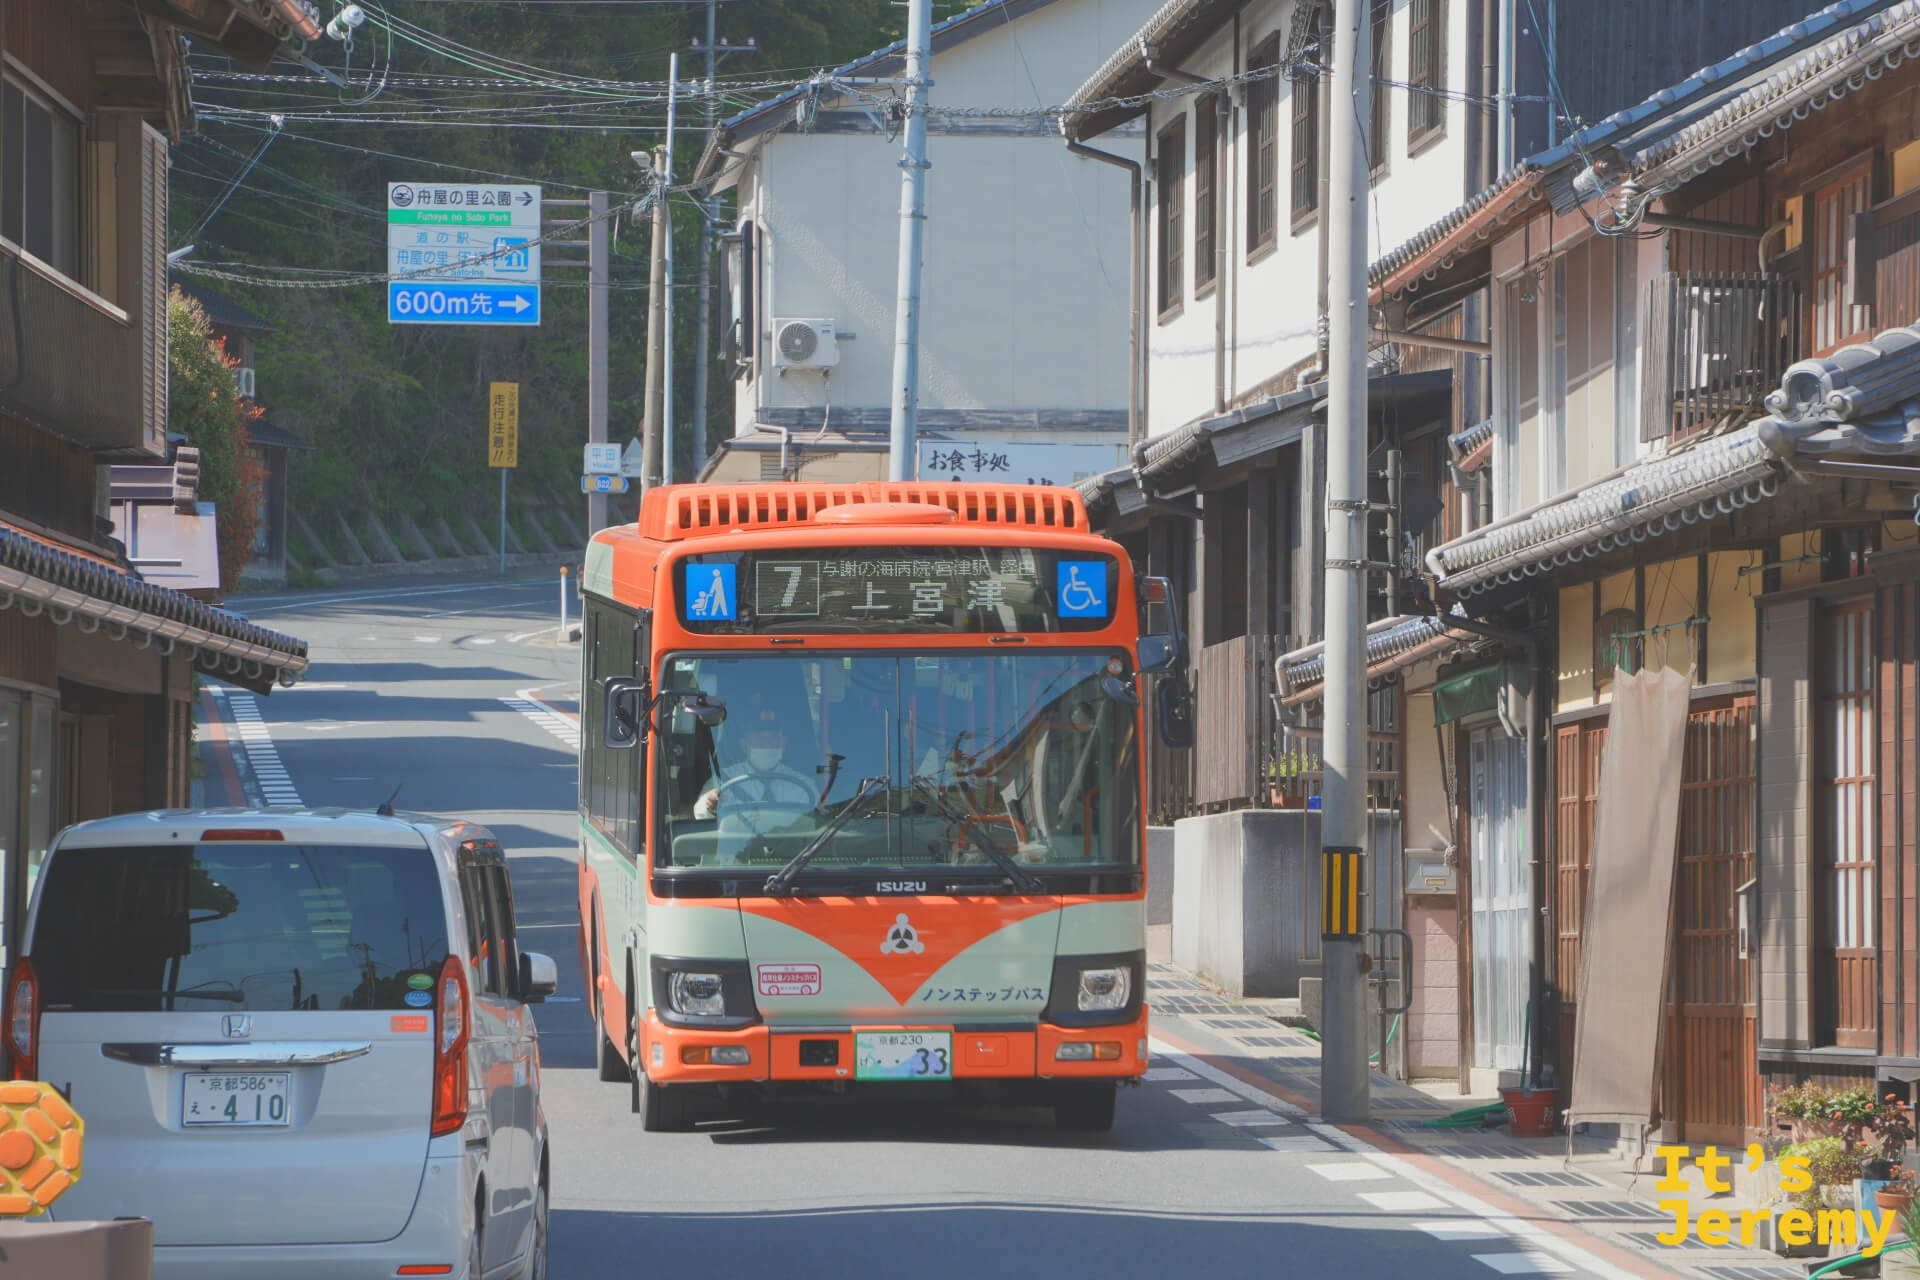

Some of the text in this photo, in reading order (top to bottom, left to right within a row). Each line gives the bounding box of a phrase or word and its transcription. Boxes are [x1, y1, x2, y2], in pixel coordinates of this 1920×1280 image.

[417, 190, 511, 206] 舟屋の里公園
[466, 212, 485, 221] Sato
[489, 212, 510, 222] Park
[416, 232, 469, 244] 道の駅
[397, 251, 448, 266] 舟屋の里
[396, 291, 493, 314] 600m先
[928, 449, 1010, 472] お食事処
[774, 566, 802, 607] 7
[851, 579, 1007, 613] 上宮津
[876, 881, 927, 892] ISUZU
[923, 986, 1044, 1001] ノンステップバス
